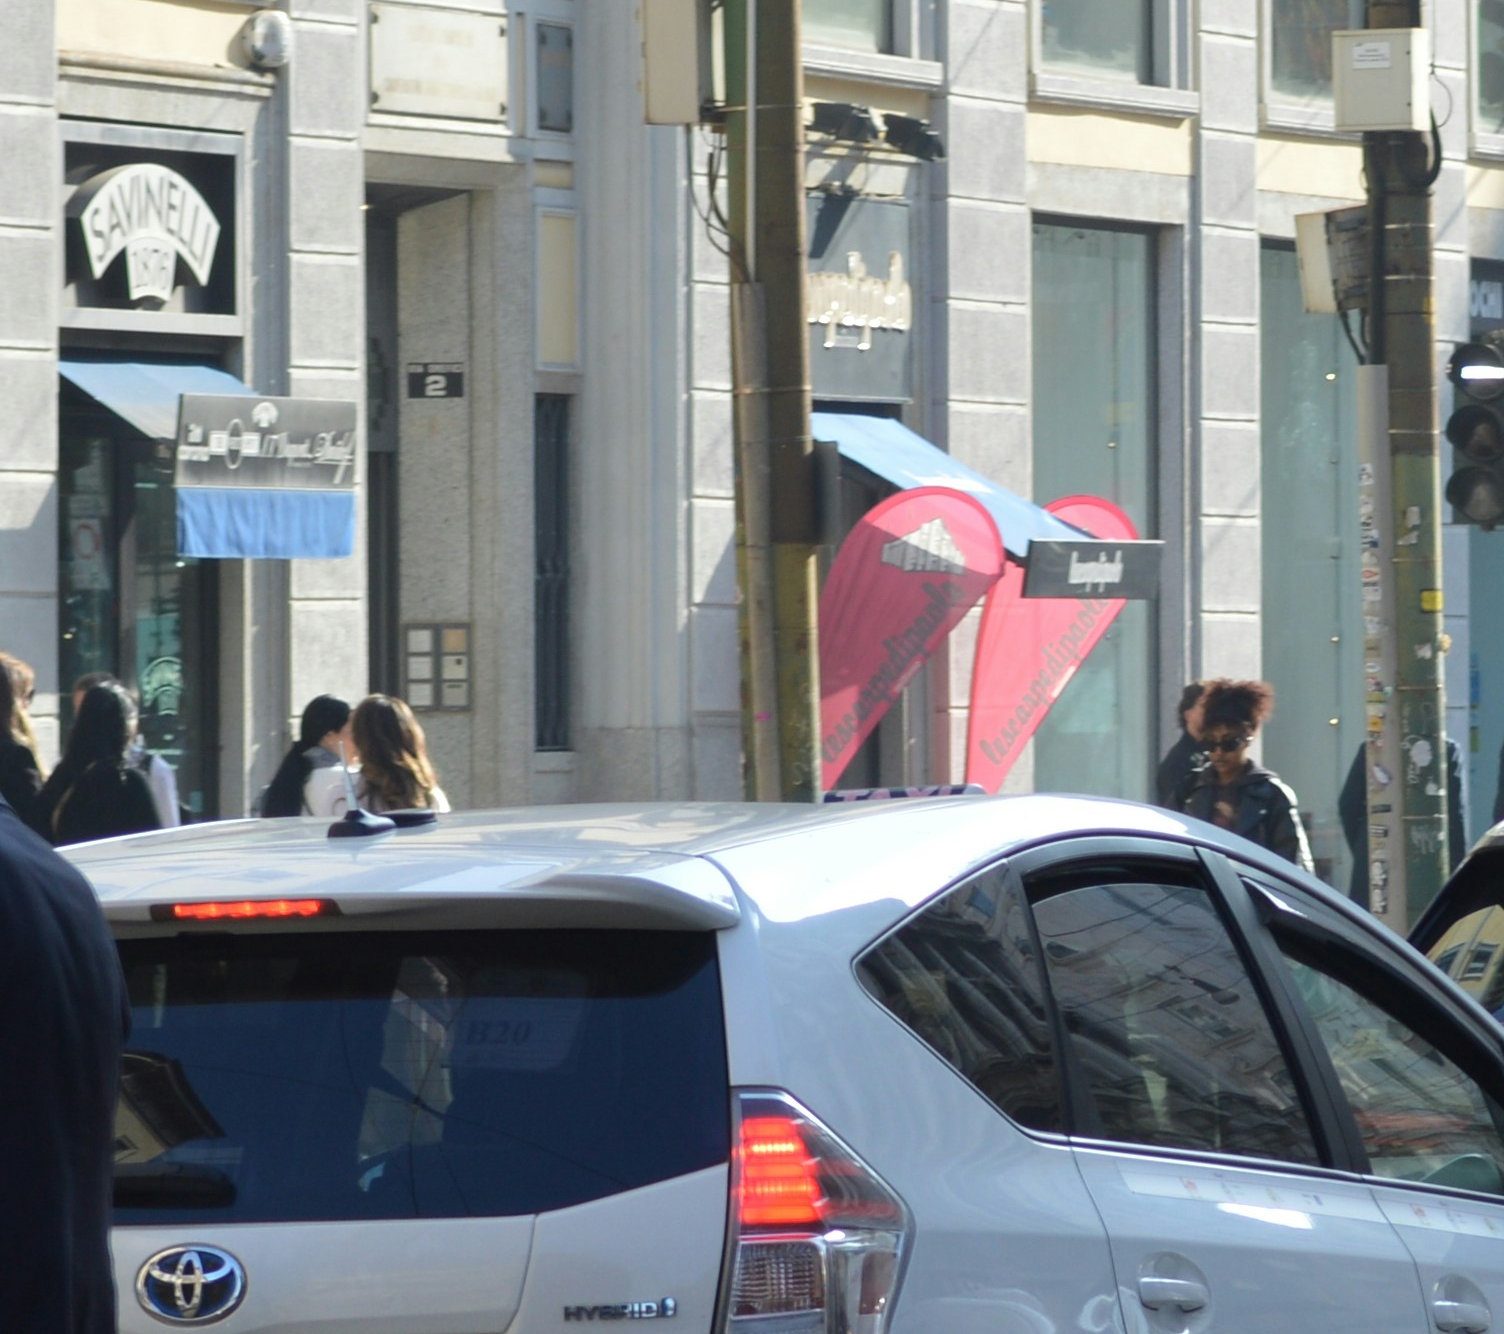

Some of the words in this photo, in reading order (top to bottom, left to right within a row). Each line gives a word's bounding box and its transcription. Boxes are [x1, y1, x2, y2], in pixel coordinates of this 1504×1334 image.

[90, 173, 212, 269] SAVINELLI
[424, 374, 447, 397] 2
[978, 598, 1106, 766] lescarpedipaol
[563, 1301, 659, 1322] HYBRID
